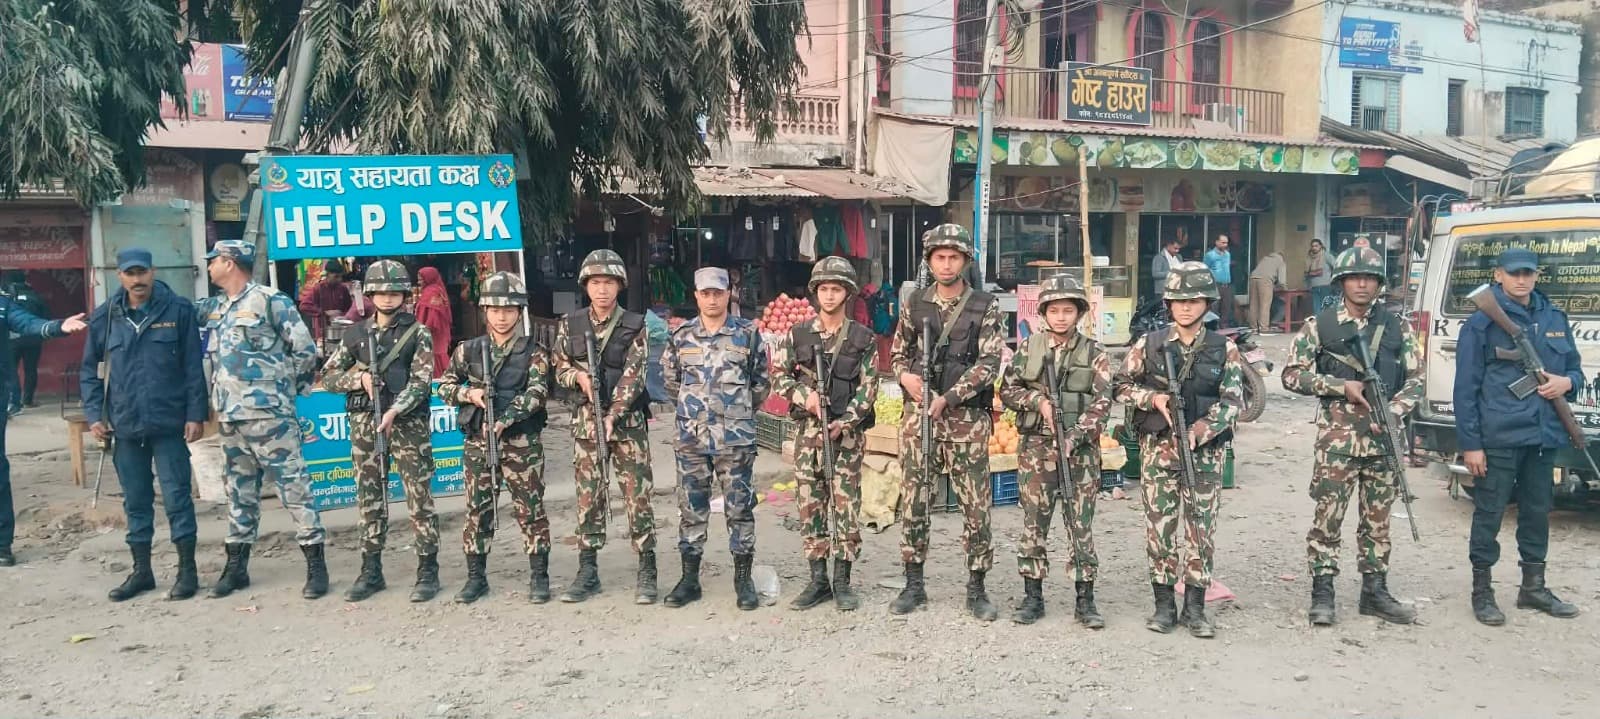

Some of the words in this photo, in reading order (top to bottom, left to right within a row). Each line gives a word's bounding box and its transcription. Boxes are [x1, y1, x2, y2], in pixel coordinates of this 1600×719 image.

[1106, 81, 1147, 113] हाउस
[296, 168, 344, 194] यात्रु
[349, 166, 431, 189] सहायता
[438, 165, 480, 187] कक्ष
[274, 204, 386, 248] HELP
[401, 201, 512, 243] DESK
[1560, 239, 1587, 256] Nepal
